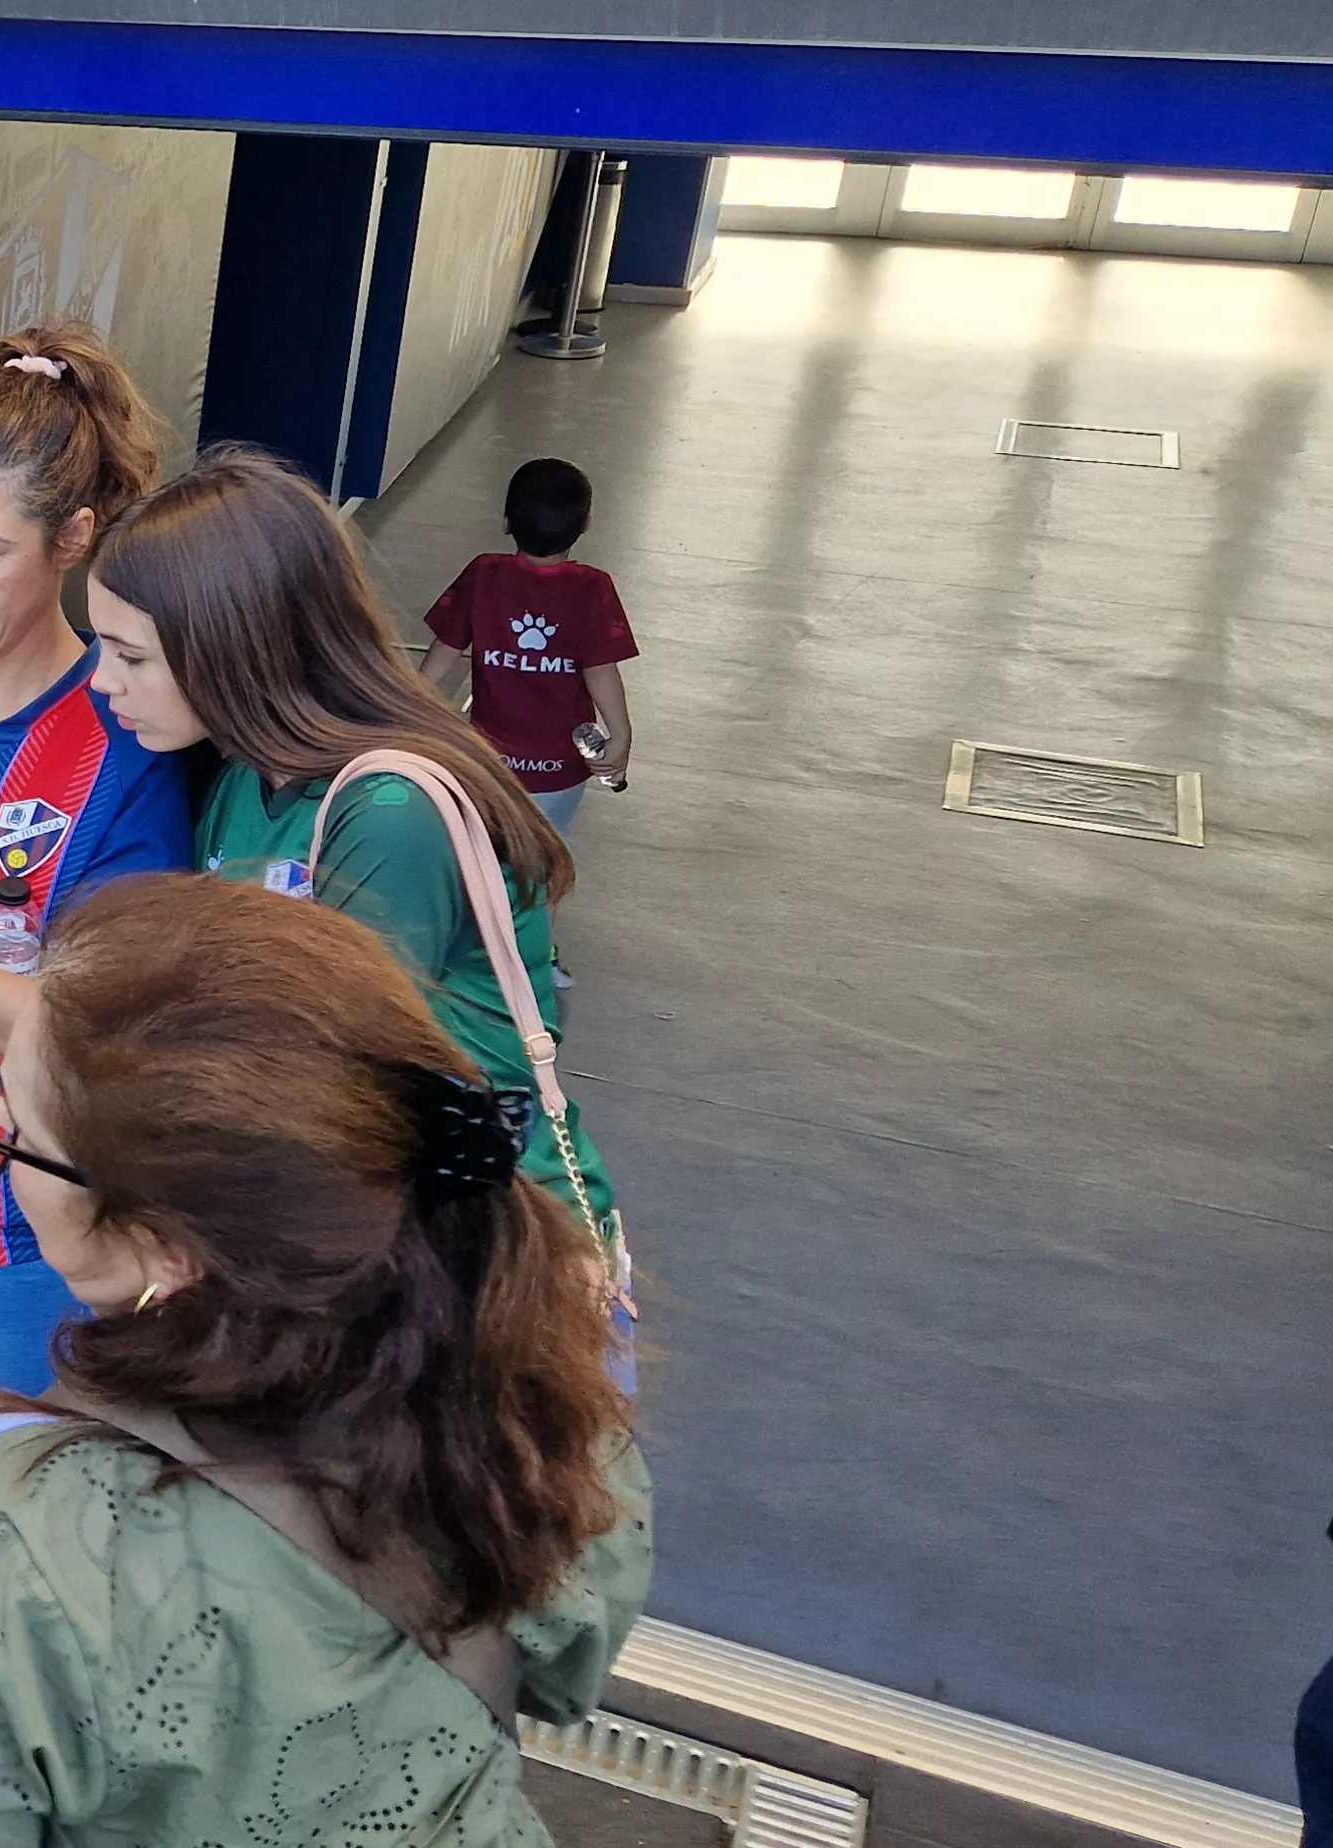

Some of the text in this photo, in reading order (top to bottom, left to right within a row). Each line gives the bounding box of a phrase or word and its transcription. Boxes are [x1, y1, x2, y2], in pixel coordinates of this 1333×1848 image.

[484, 649, 576, 673] KELME
[498, 754, 564, 772] OMMOS
[21, 820, 62, 838] HUESCA
